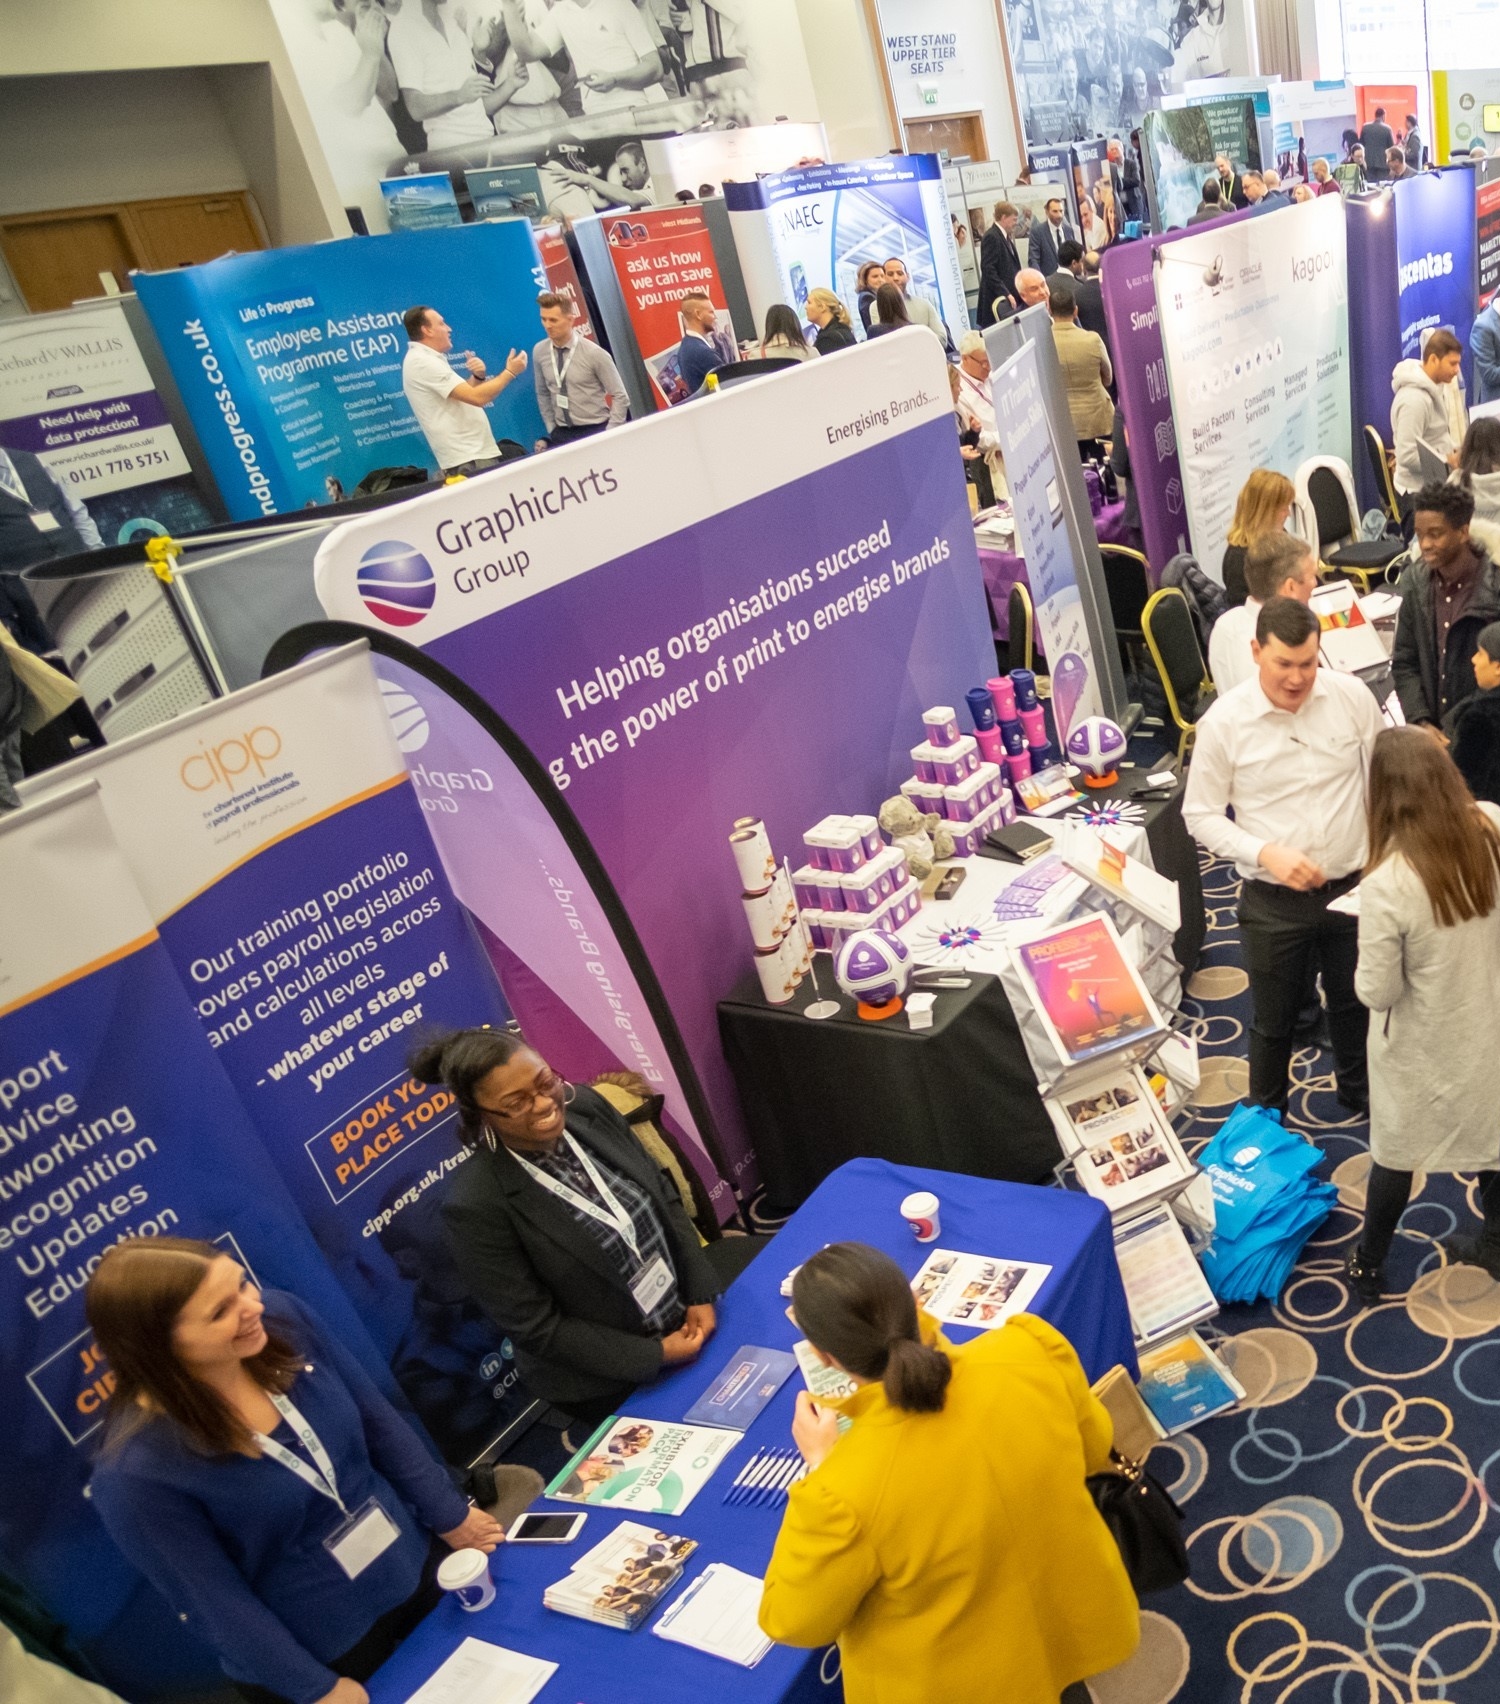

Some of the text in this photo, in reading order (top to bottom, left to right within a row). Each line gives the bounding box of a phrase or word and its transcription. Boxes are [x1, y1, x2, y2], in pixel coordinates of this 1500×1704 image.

[887, 33, 957, 49] WEST STAND
[892, 47, 957, 62] UPPER TIER
[910, 61, 944, 75] SEATS
[1207, 109, 1217, 118] We
[1033, 155, 1060, 170] VISTAGE
[784, 203, 824, 231] NAEC
[626, 250, 702, 274] ask us how
[937, 185, 947, 211] ONE
[950, 256, 966, 312] LIMITLESS
[631, 265, 713, 291] we can save
[1239, 262, 1263, 279] ORACLE
[1291, 249, 1335, 284] kagool
[1486, 267, 1498, 283] PLAN
[239, 307, 259, 323] Life
[266, 296, 315, 316] Progress
[636, 292, 663, 312] you
[59, 336, 124, 360] WALLIS
[245, 326, 322, 361] Employee
[257, 332, 399, 386] Programme (EAP)
[1316, 350, 1338, 369] Products
[1284, 366, 1308, 387] Managed
[1316, 363, 1339, 383] Solutions
[344, 396, 377, 411] Coaching
[1244, 384, 1276, 411] Consulting
[1284, 380, 1307, 401] Services
[39, 401, 131, 430] Need help with
[182, 318, 279, 517] ndprogress.co.uk
[347, 404, 394, 421] Development
[825, 404, 889, 445] Energising
[1192, 407, 1236, 440] Build Factory
[1246, 404, 1271, 425] Services
[45, 416, 140, 446] data protection?
[353, 422, 390, 438] Workplace
[1194, 432, 1223, 455] Services
[69, 449, 170, 484] 0121 778 5751
[435, 467, 618, 558] GraphicArts
[453, 545, 532, 597] Group
[555, 518, 893, 720] Helping organisations succeed
[547, 536, 952, 791] g the power of print to energise brands
[180, 725, 282, 792] cipp
[212, 780, 301, 828] payroll professionals
[213, 771, 294, 813] chartered institute
[189, 850, 410, 983] Our training portfolio
[193, 865, 436, 1020] overs payroll legislation
[206, 895, 442, 1049] and calculations across
[299, 960, 387, 1026] all levels
[266, 950, 451, 1082] whatever stage of
[307, 1002, 425, 1094] your career
[330, 1095, 396, 1155] BOOK
[335, 1128, 404, 1186] PLACE
[361, 1142, 476, 1239] cipp.org.uk/trai
[1207, 1163, 1257, 1193] GraphicArts
[15, 1180, 151, 1279] Updates
[25, 1204, 181, 1320] Eduction
[648, 1426, 674, 1455] PACK
[625, 1428, 685, 1503] INFORMATION
[648, 1429, 694, 1489] EXHIBITOR
